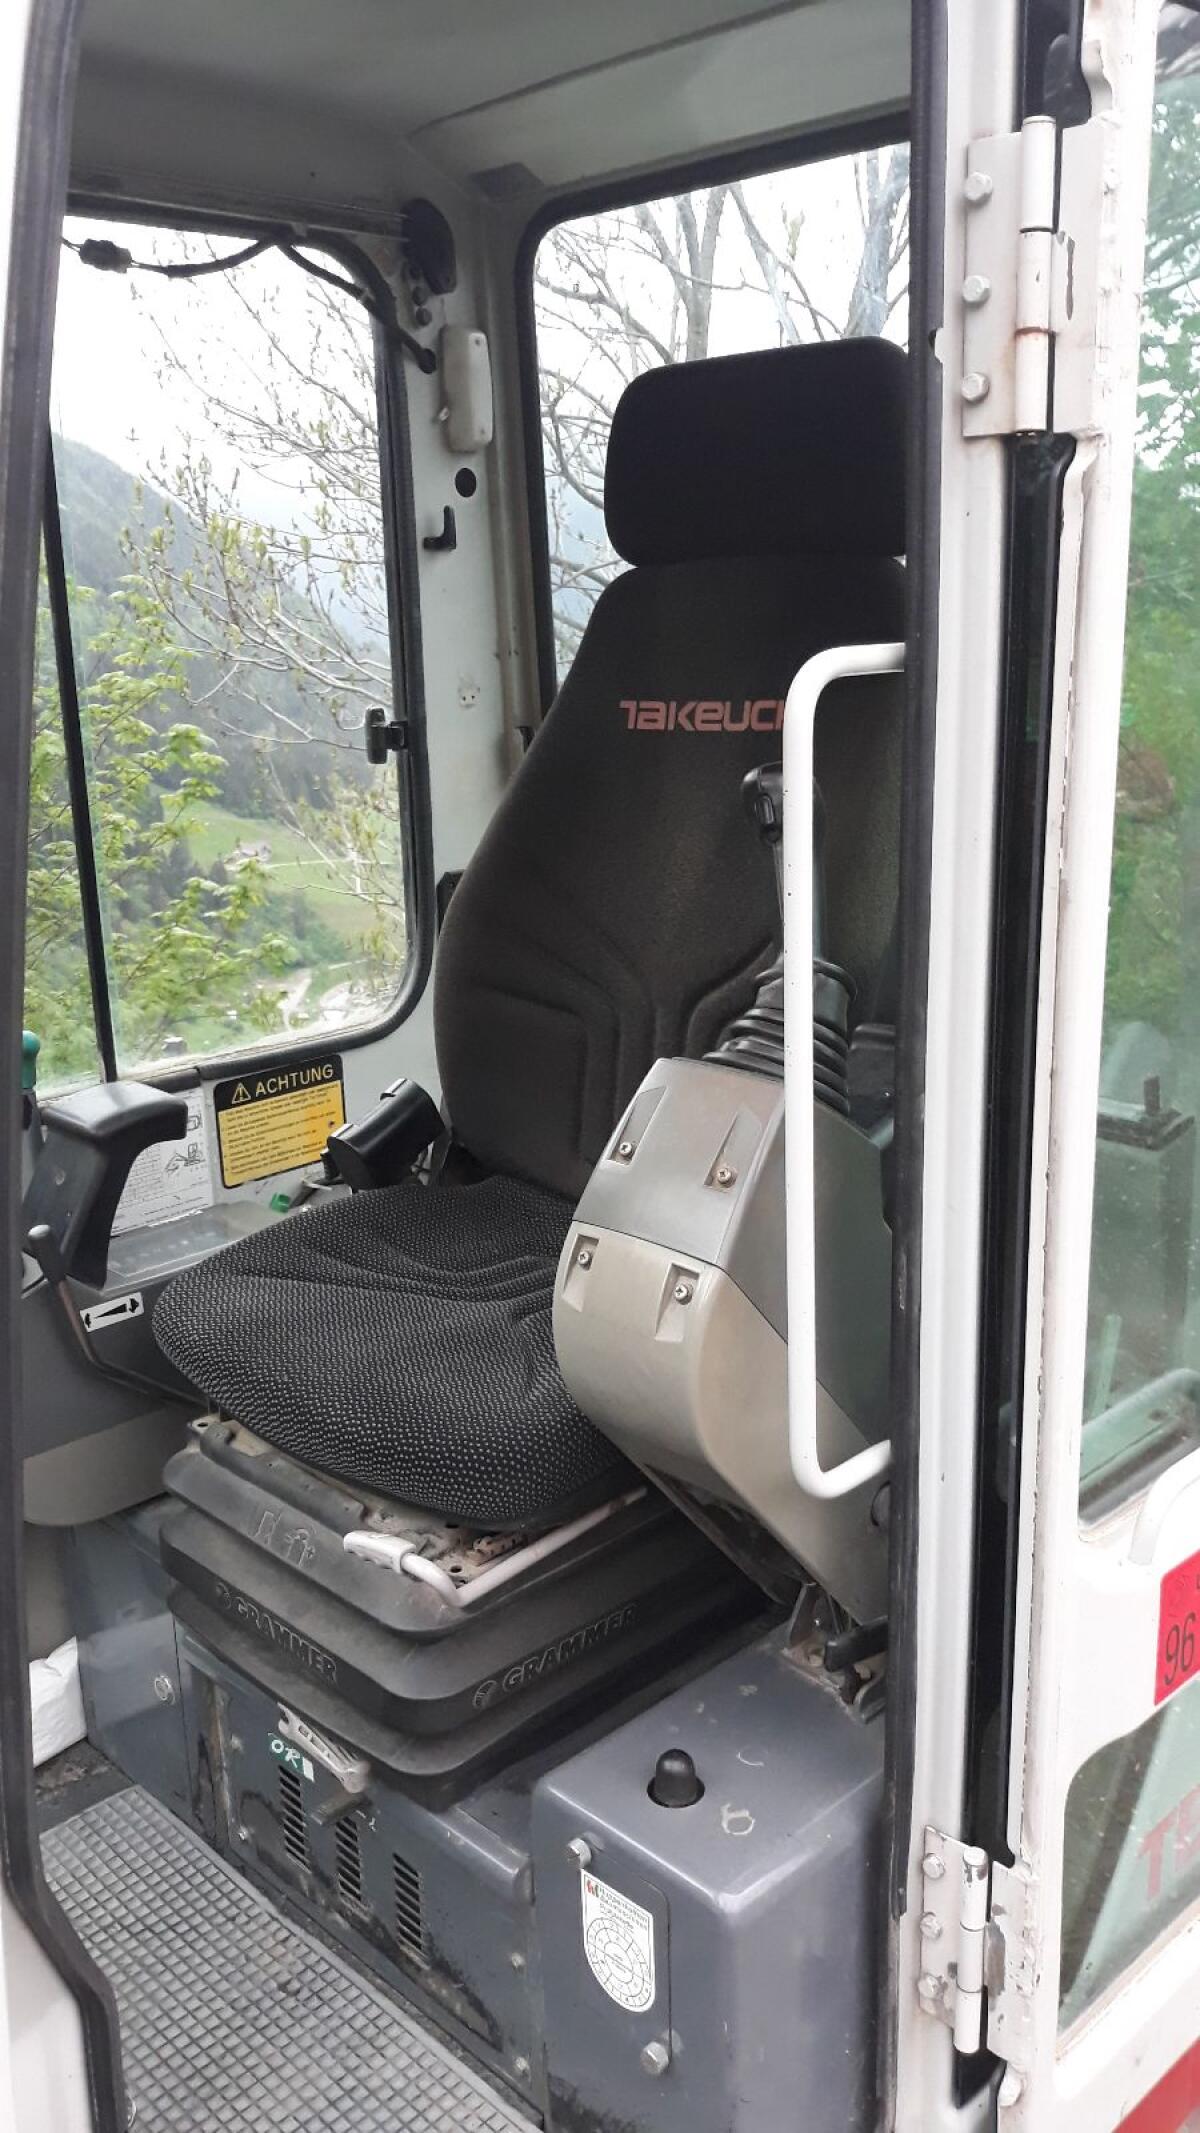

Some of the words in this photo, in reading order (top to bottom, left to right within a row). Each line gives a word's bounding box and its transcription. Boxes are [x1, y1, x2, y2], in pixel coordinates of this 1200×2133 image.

[255, 1063, 335, 1098] ACHTUNG
[232, 1596, 338, 1687] GRAMMER
[502, 1603, 638, 1692] GRAMMER
[1164, 1611, 1196, 1686] 96
